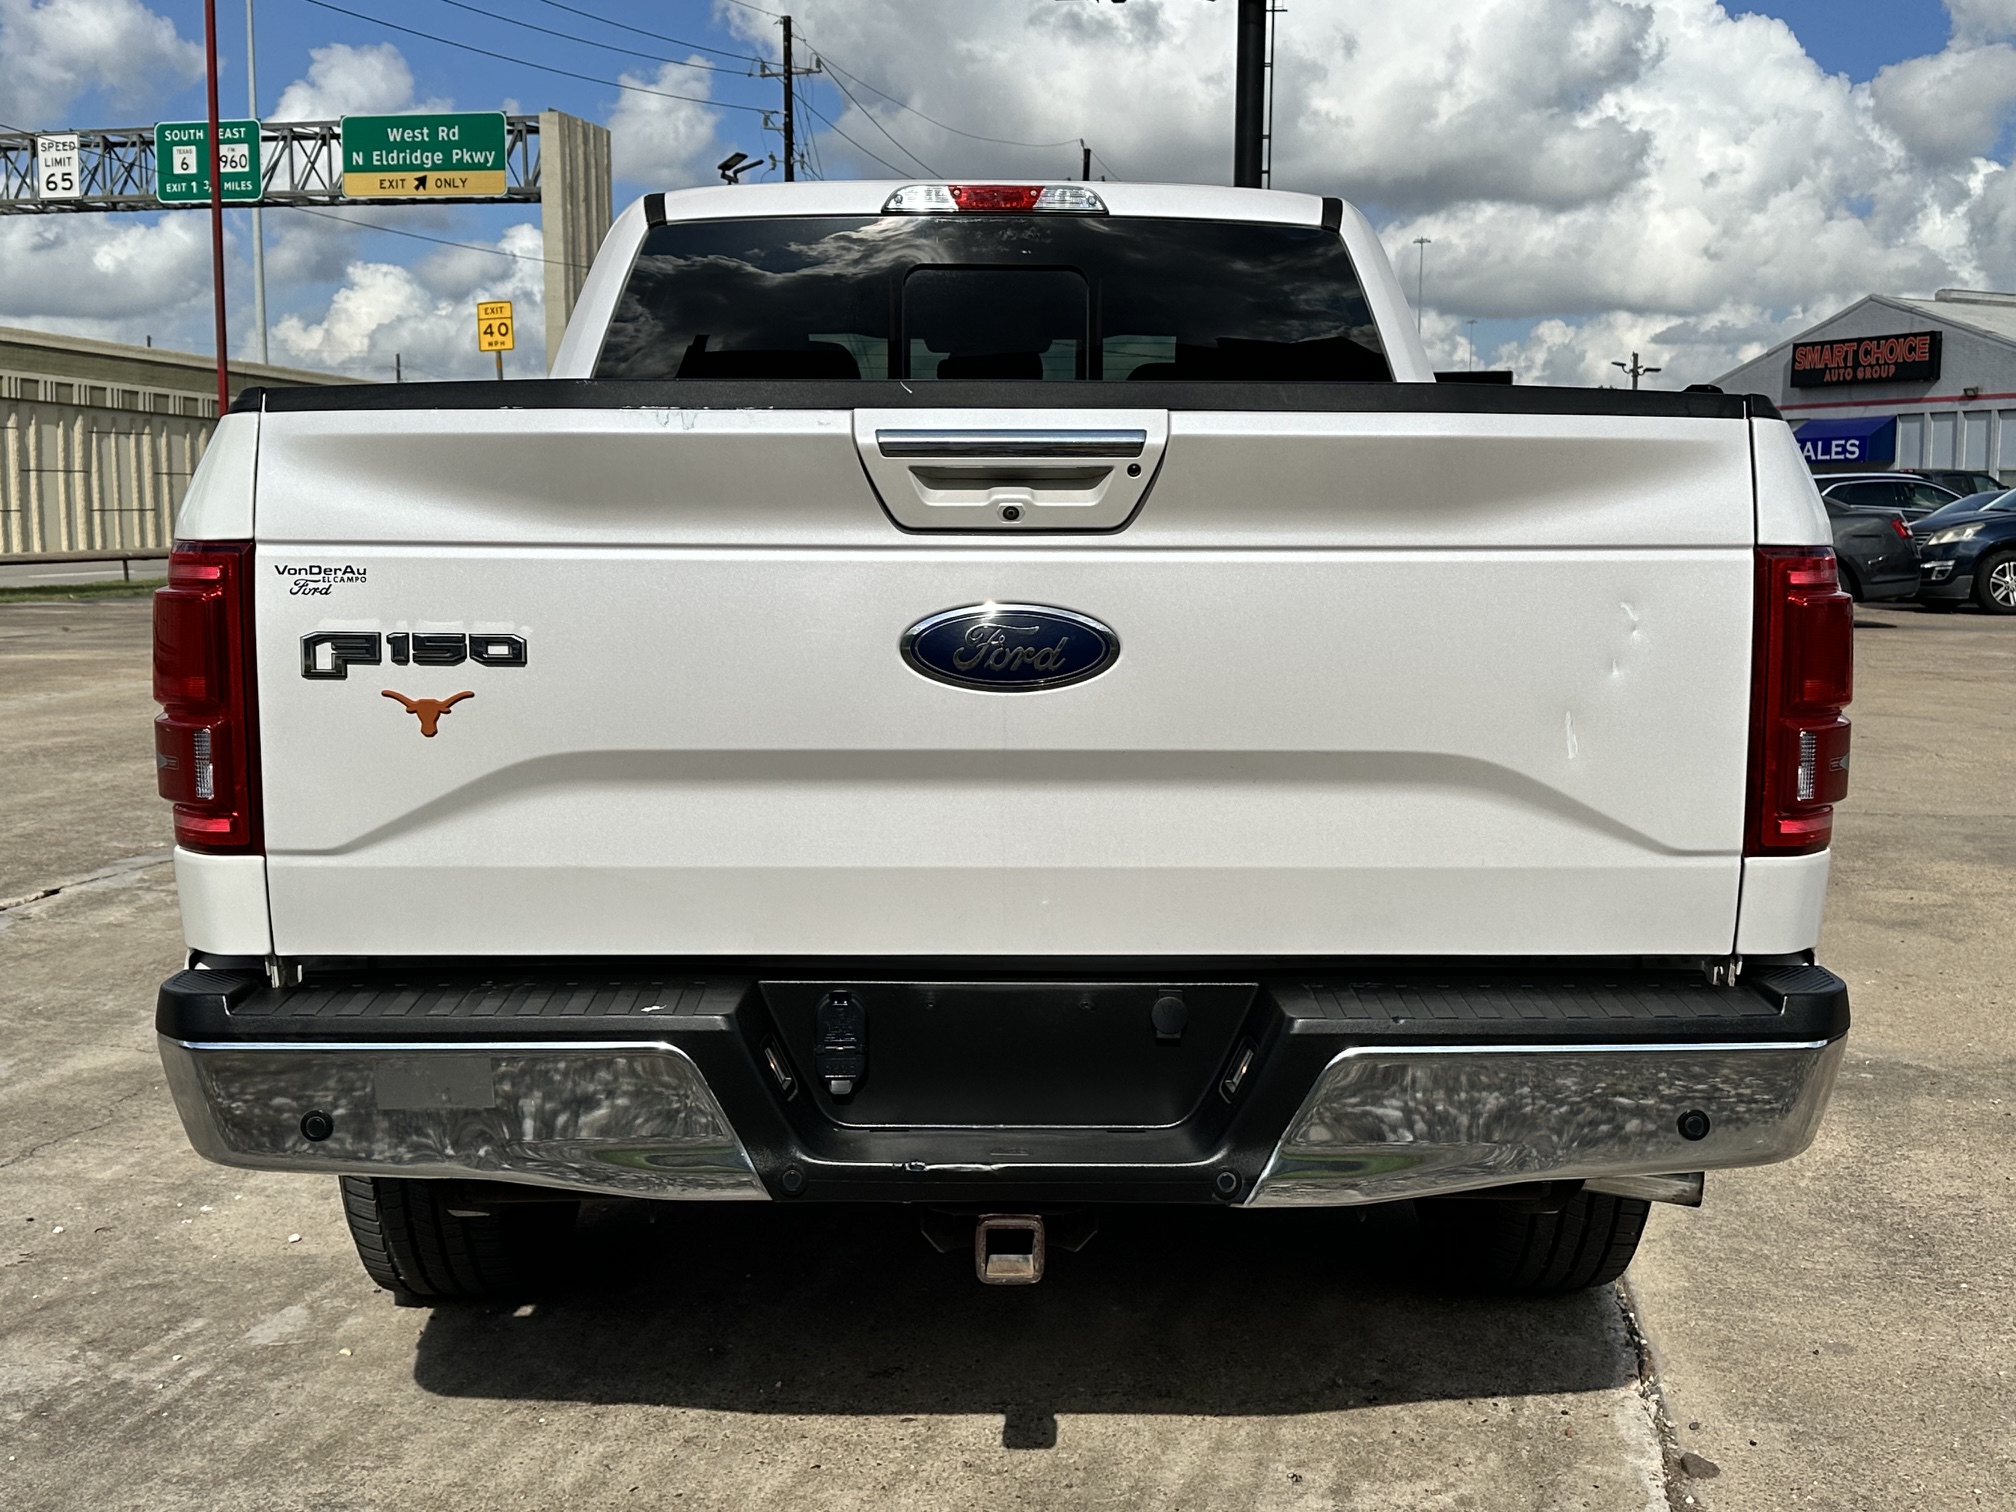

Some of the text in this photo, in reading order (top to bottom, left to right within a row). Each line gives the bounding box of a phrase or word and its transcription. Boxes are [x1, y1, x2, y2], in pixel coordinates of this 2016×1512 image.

[165, 129, 204, 141] SOUTH
[218, 128, 246, 139] EAST
[387, 125, 459, 142] West Rd
[40, 141, 76, 152] SPEED
[44, 156, 72, 168] LIMIT
[180, 156, 189, 171] 6
[219, 153, 248, 169] 960
[352, 148, 496, 168] N Eldridge Pkwy
[45, 172, 74, 192] 65
[166, 182, 187, 193] EXIT
[191, 181, 197, 194] 1
[224, 180, 253, 191] MILES
[379, 177, 468, 190] EXIT ONLY
[484, 305, 505, 316] EXIT
[483, 322, 509, 337] 40
[487, 340, 506, 348] MPH
[1794, 336, 1930, 371] SMART CHOICE
[1824, 364, 1896, 382] AUTO GROUP
[1799, 439, 1860, 461] ALES
[274, 564, 367, 576] VonDerAu
[289, 578, 332, 597] Ford
[322, 576, 367, 584] EL CAMPO
[952, 622, 1069, 672] Ford
